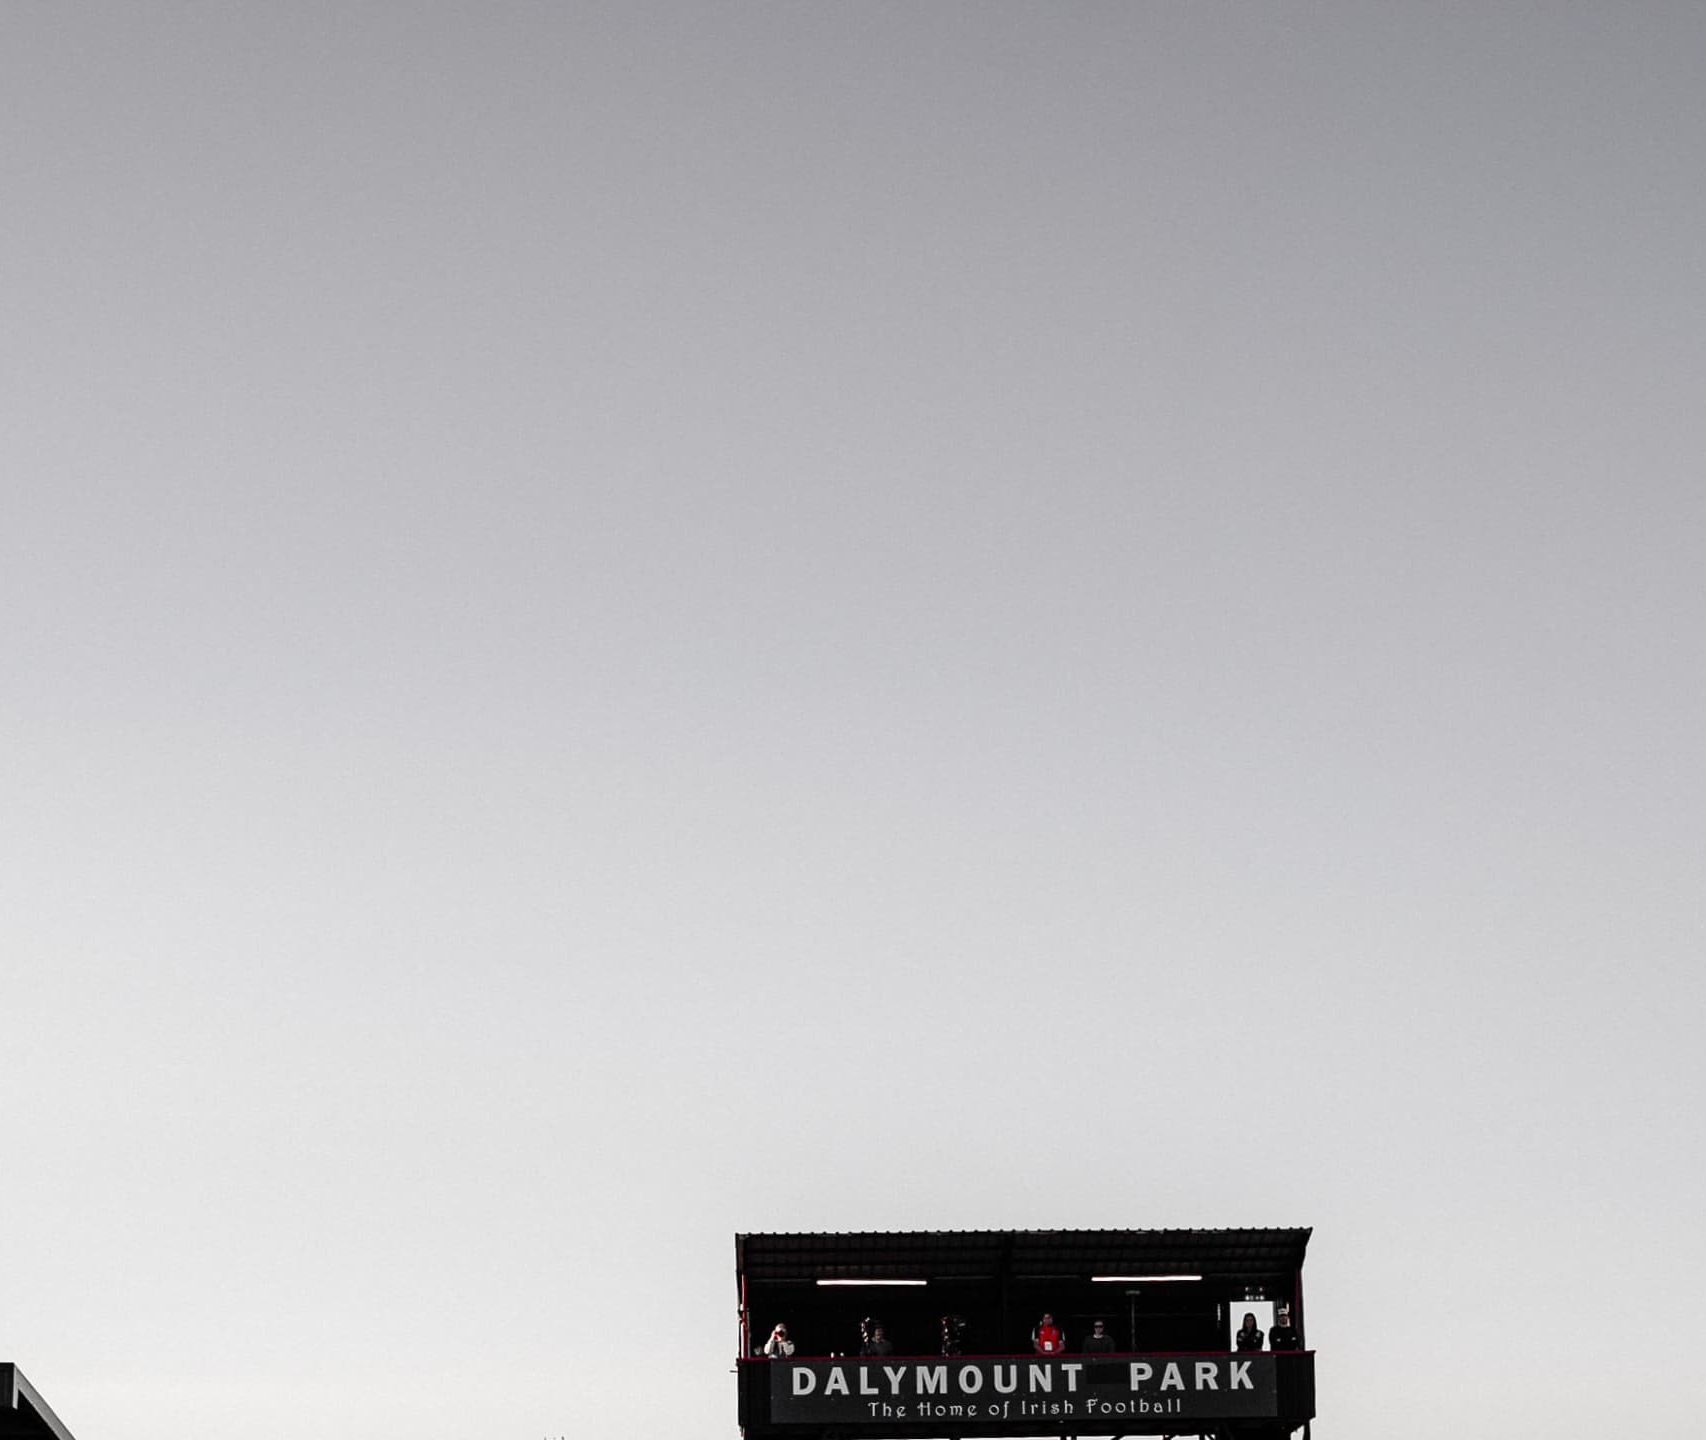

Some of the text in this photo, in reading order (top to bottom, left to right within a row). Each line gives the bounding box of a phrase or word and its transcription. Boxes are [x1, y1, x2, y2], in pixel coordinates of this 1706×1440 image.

[792, 1361, 1255, 1396] DALYMOUNT PARK
[868, 1398, 1182, 1418] The Home of Irish Football
